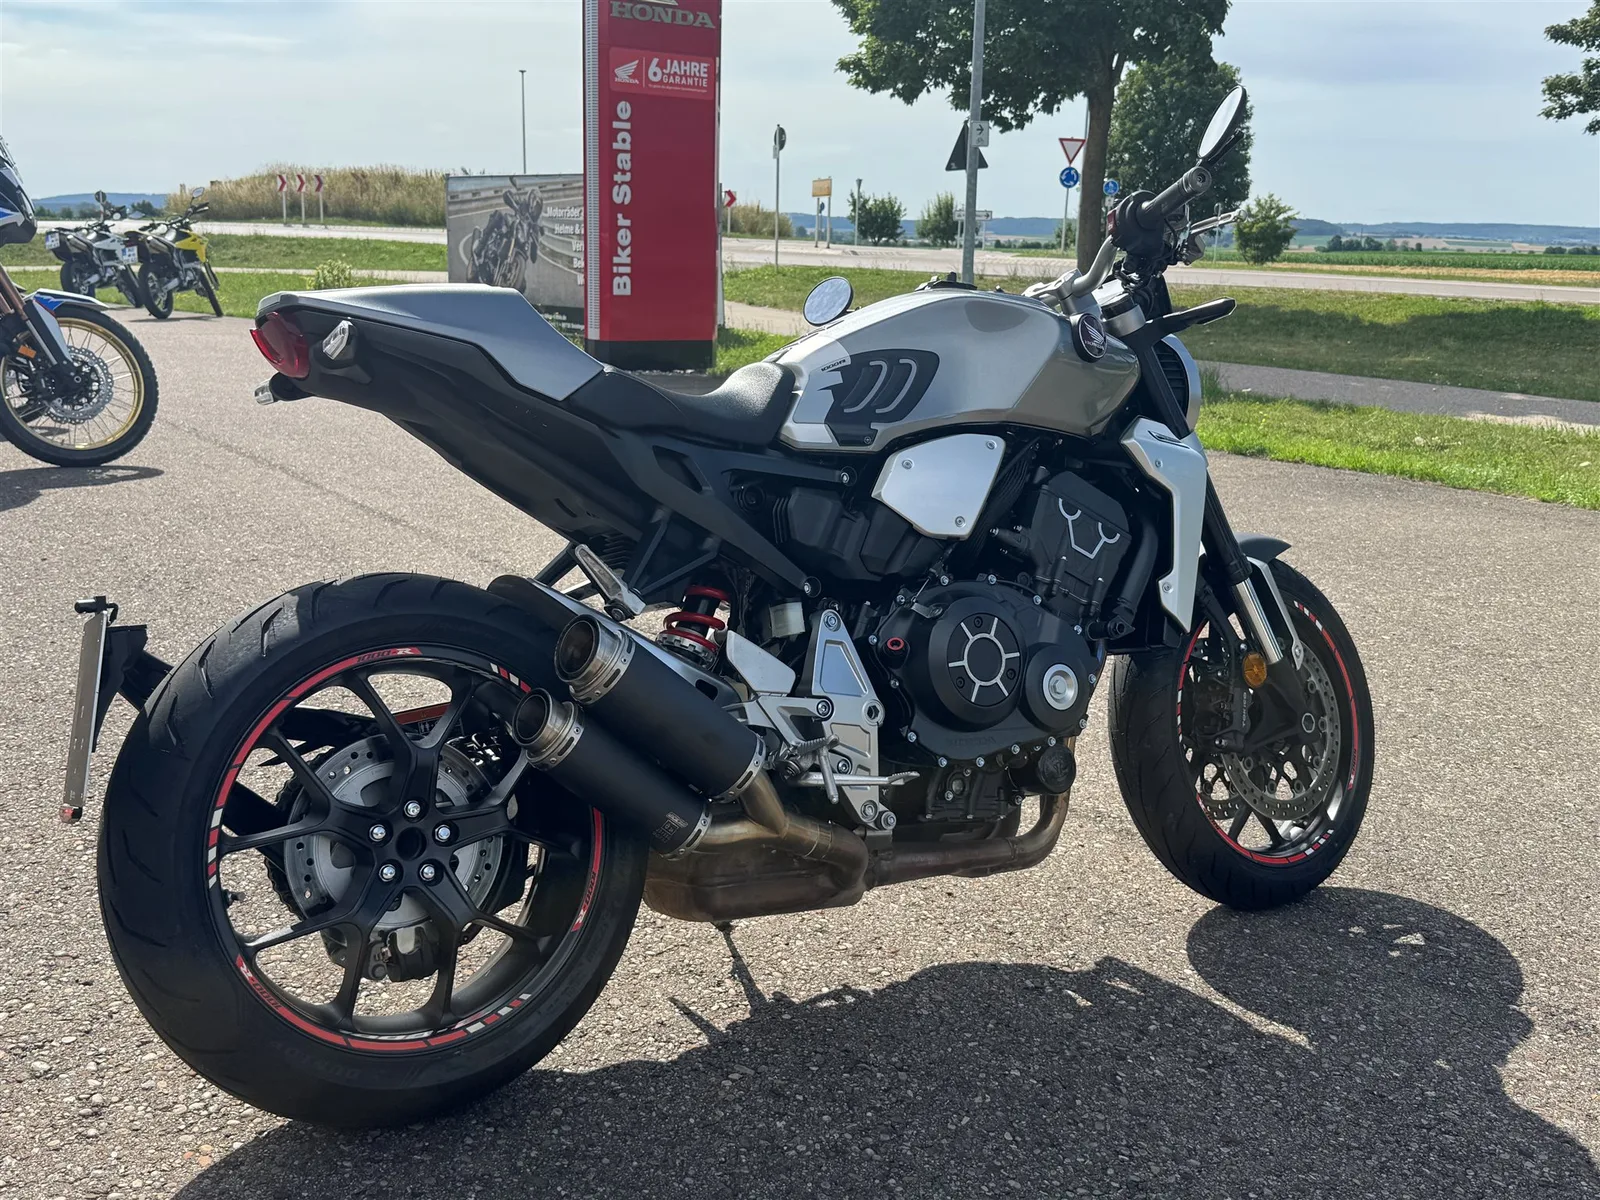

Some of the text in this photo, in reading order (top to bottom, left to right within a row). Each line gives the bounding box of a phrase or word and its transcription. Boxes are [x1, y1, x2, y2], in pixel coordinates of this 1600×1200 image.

[610, 1, 716, 28] HONDA
[648, 57, 708, 82] 6 JAHRE
[614, 77, 640, 85] HONDA
[662, 75, 708, 88] GARANTIE
[612, 100, 632, 296] Biker Stable
[554, 223, 575, 235] Helme
